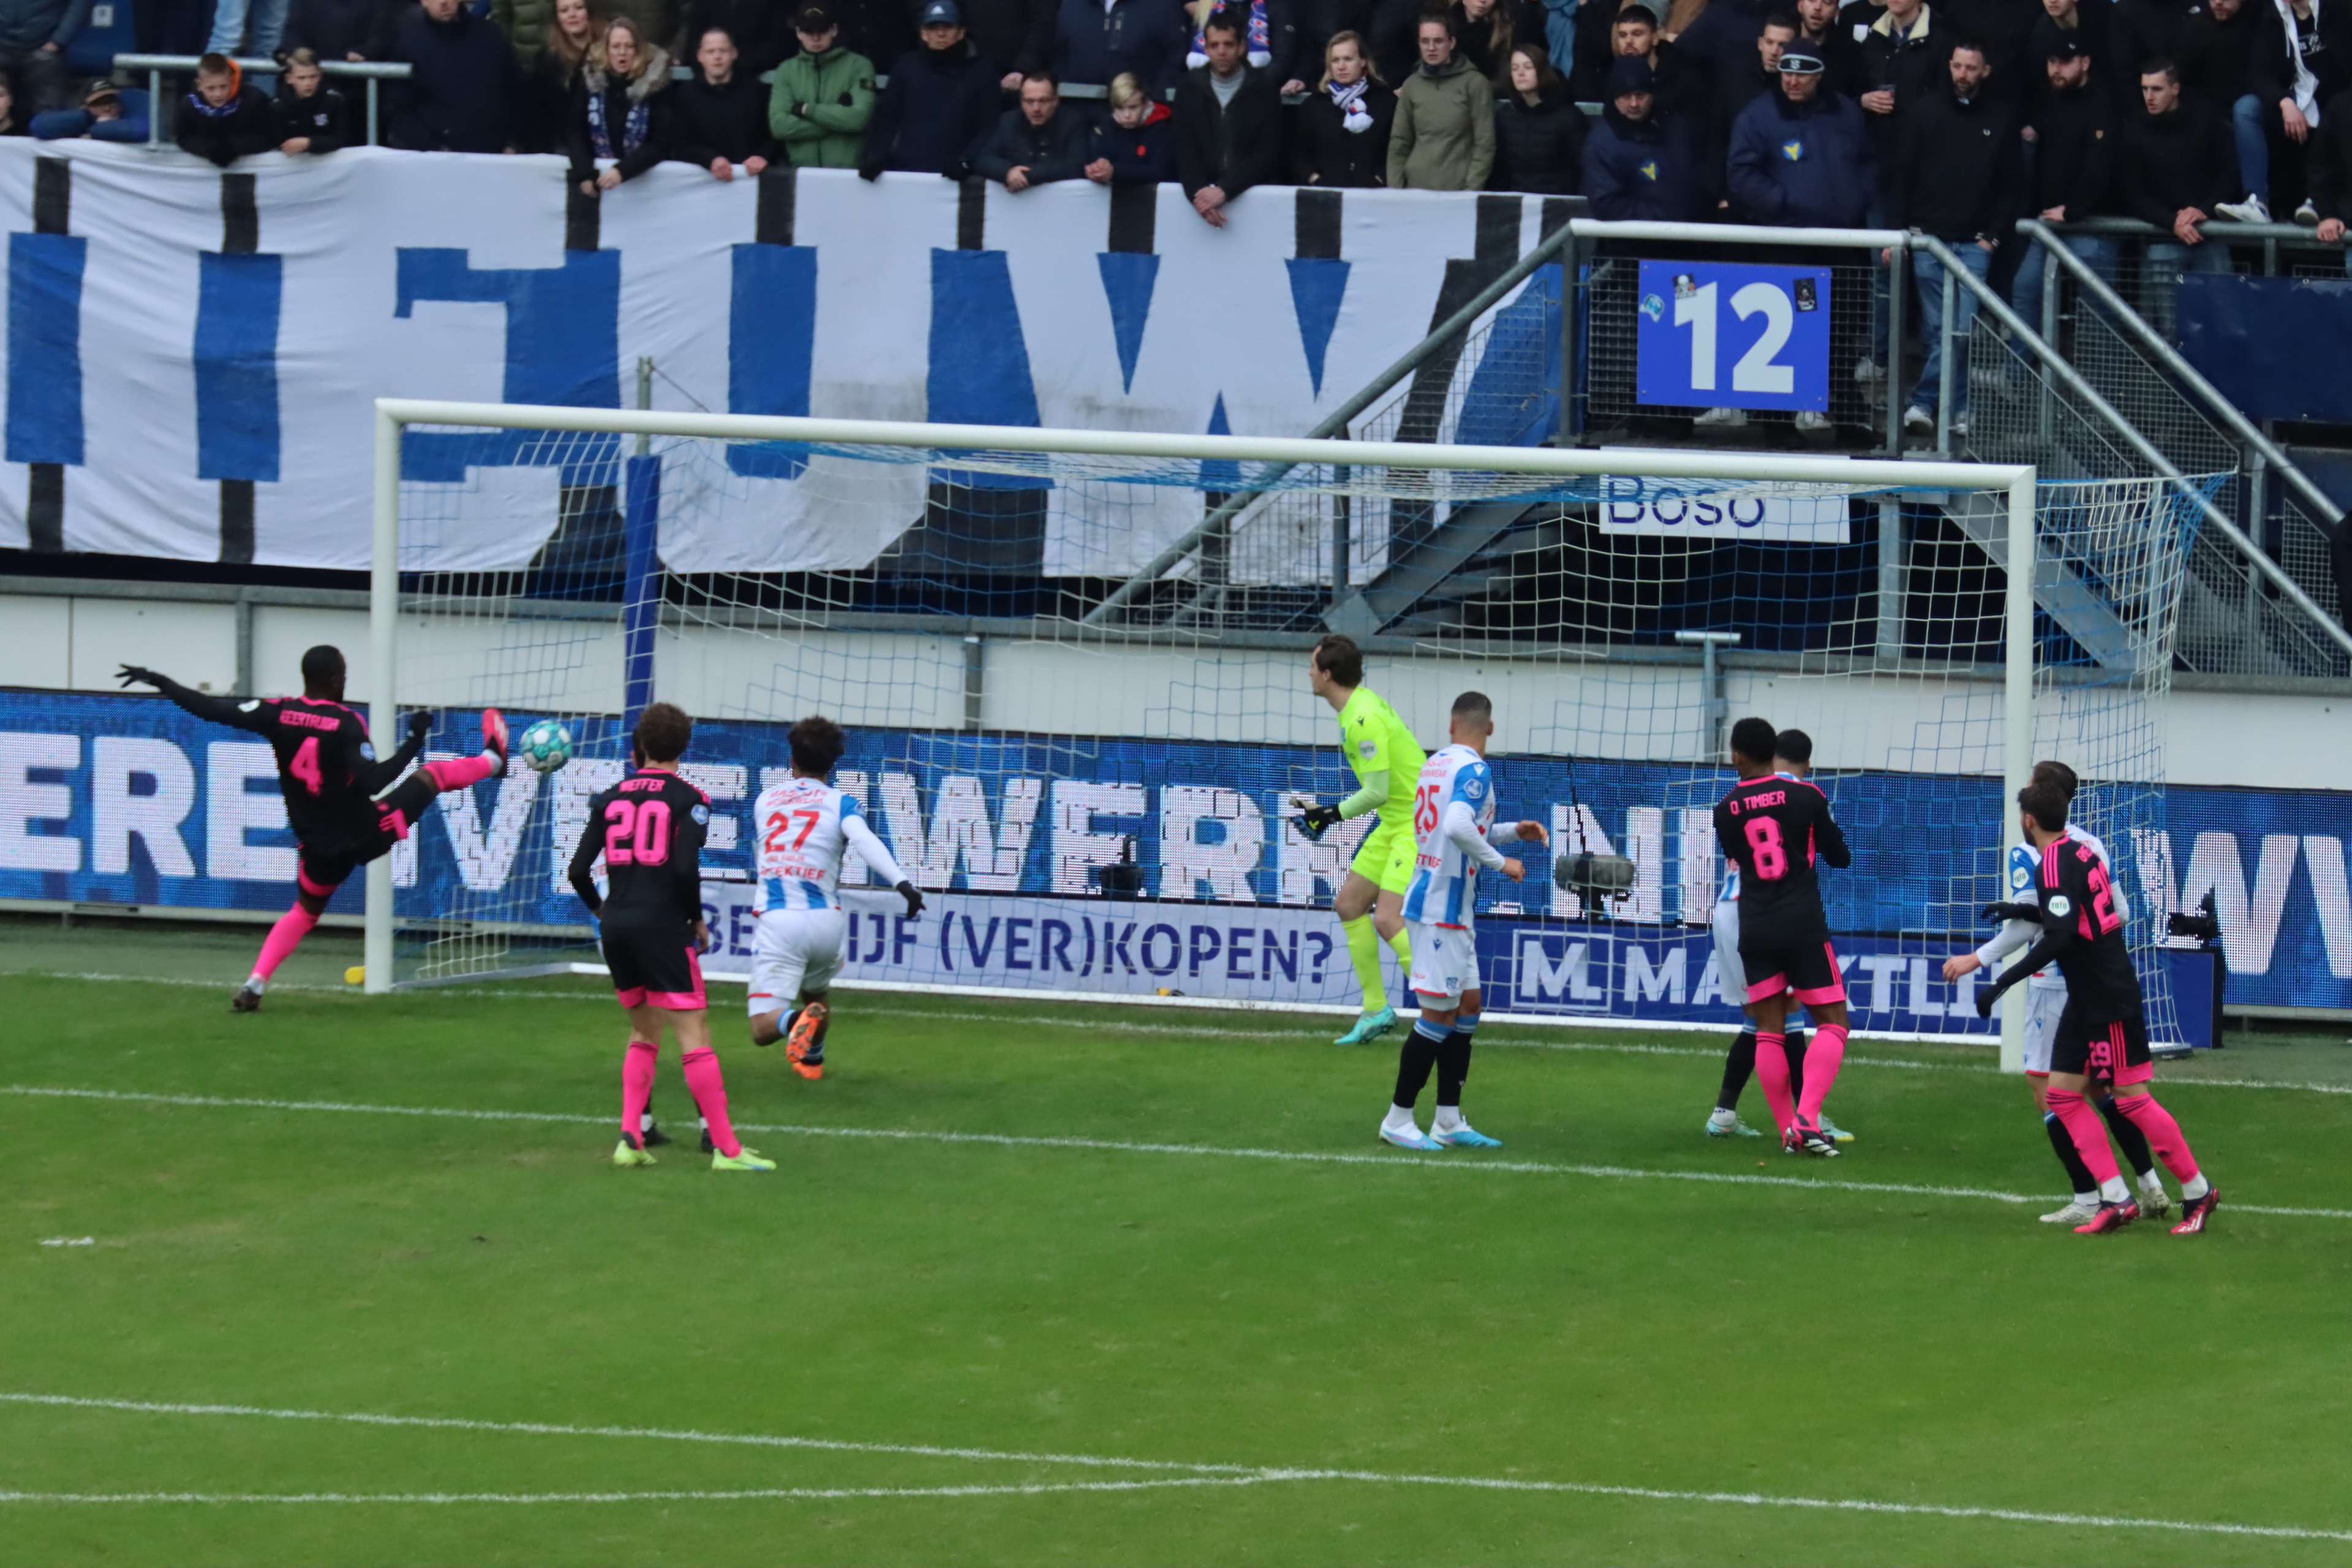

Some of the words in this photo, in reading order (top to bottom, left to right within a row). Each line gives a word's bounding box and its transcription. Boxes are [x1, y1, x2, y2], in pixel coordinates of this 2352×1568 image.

[1674, 281, 1795, 394] 12
[289, 736, 323, 796] 4
[1415, 785, 1440, 834] 25
[1744, 790, 1785, 810] TIMBER
[604, 799, 672, 865] 20
[764, 810, 820, 854] 27
[1744, 815, 1789, 881] 8
[2014, 872, 2026, 883] TOTO
[702, 903, 921, 964] BEIJF
[941, 911, 1332, 984] (VER)KOPEN?
[2089, 1041, 2112, 1066] 29
